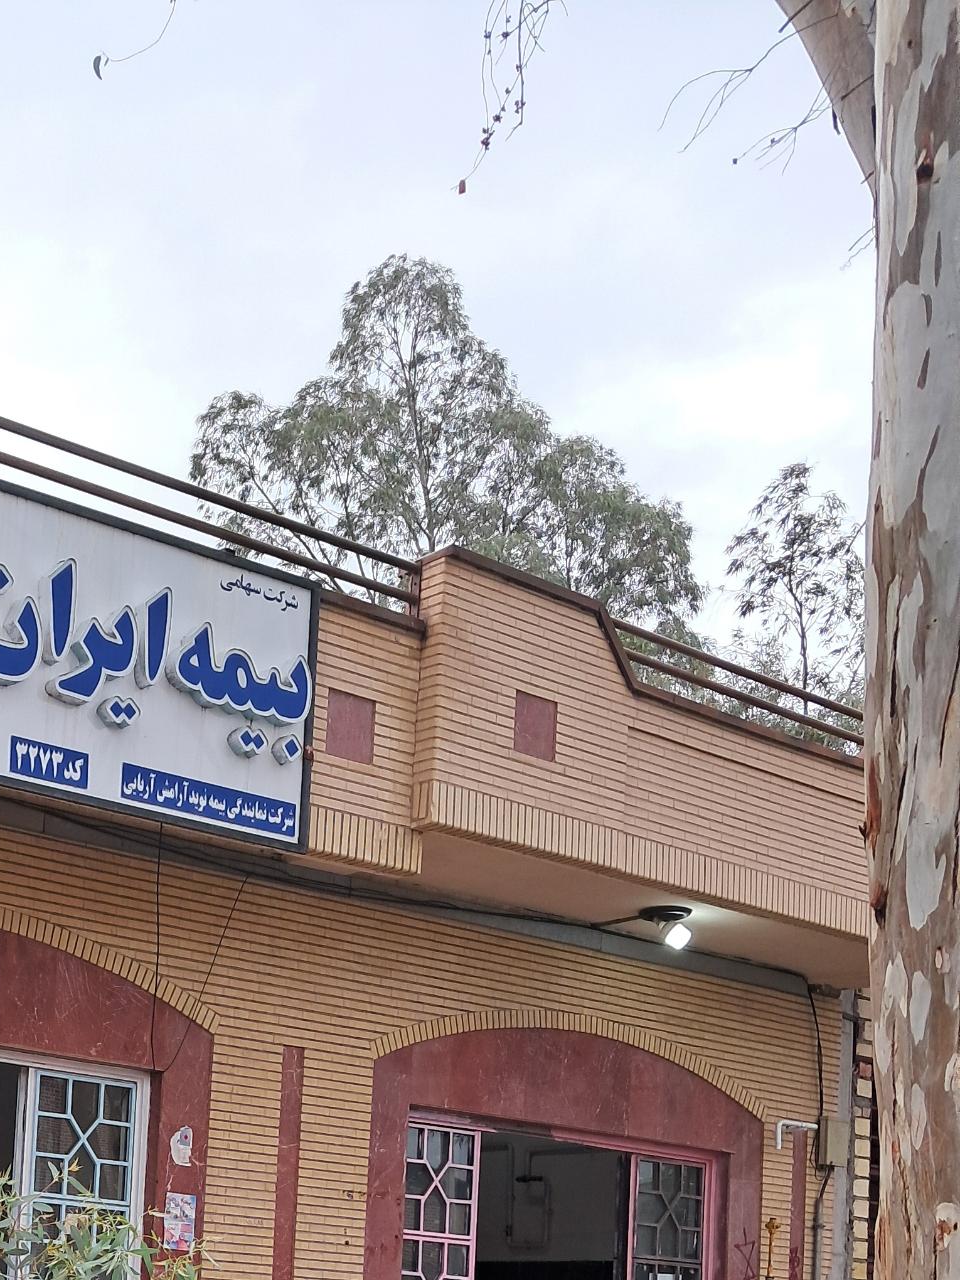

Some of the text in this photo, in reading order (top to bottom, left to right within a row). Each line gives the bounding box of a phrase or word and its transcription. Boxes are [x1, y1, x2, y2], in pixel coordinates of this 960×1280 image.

[219, 573, 299, 612] شرکت سهامی
[173, 621, 312, 763] بیمه
[15, 740, 85, 782] کد ۳۲۷۳
[123, 772, 295, 832] شرکت نمایندگی بیمه نوید آرامش آریایی
